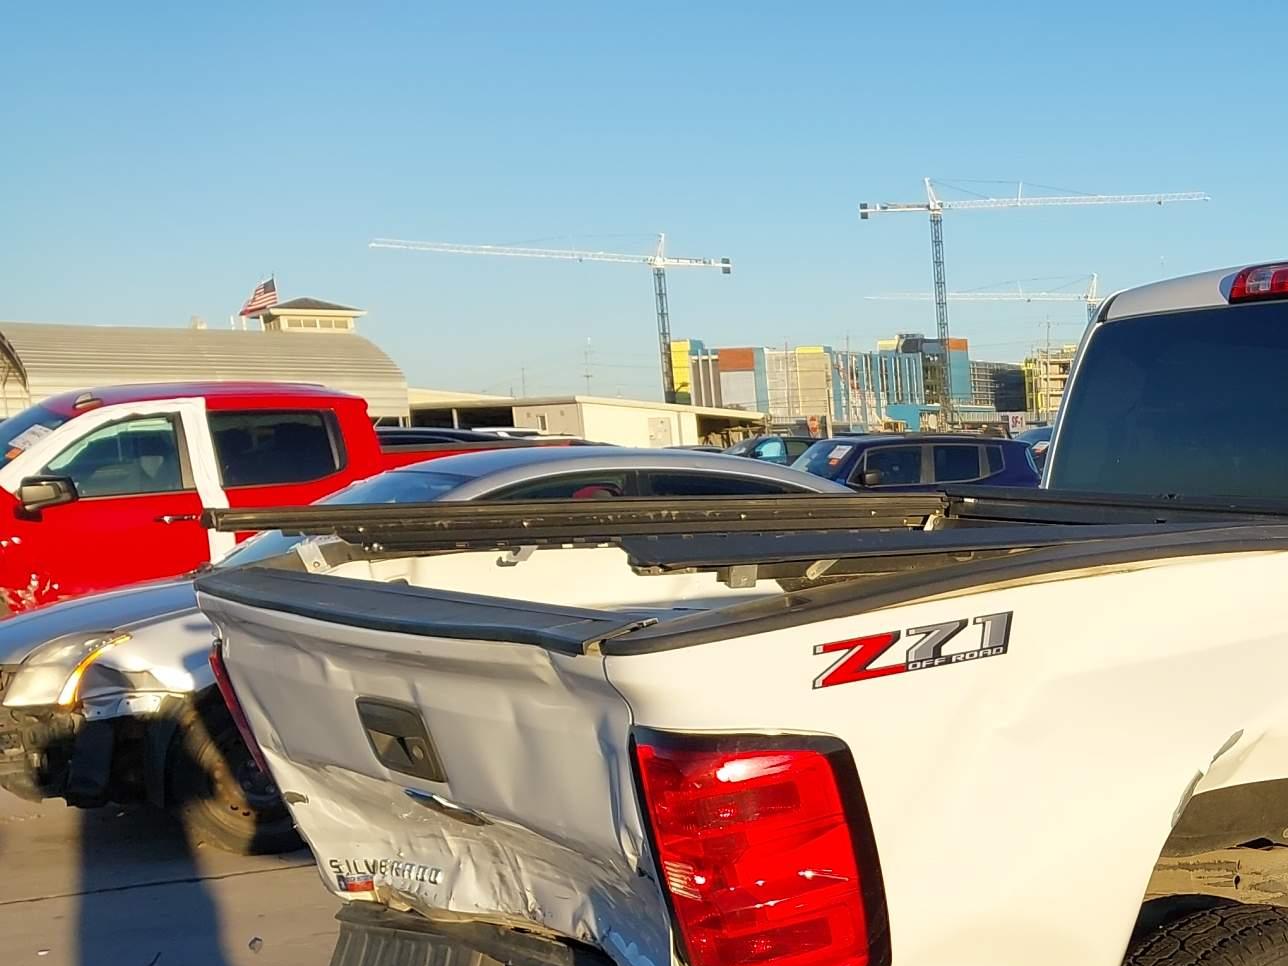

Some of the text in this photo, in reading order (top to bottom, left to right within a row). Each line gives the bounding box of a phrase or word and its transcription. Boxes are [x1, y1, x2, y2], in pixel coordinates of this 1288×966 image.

[812, 611, 1013, 689] Z71
[907, 646, 1004, 671] OFF ROAD
